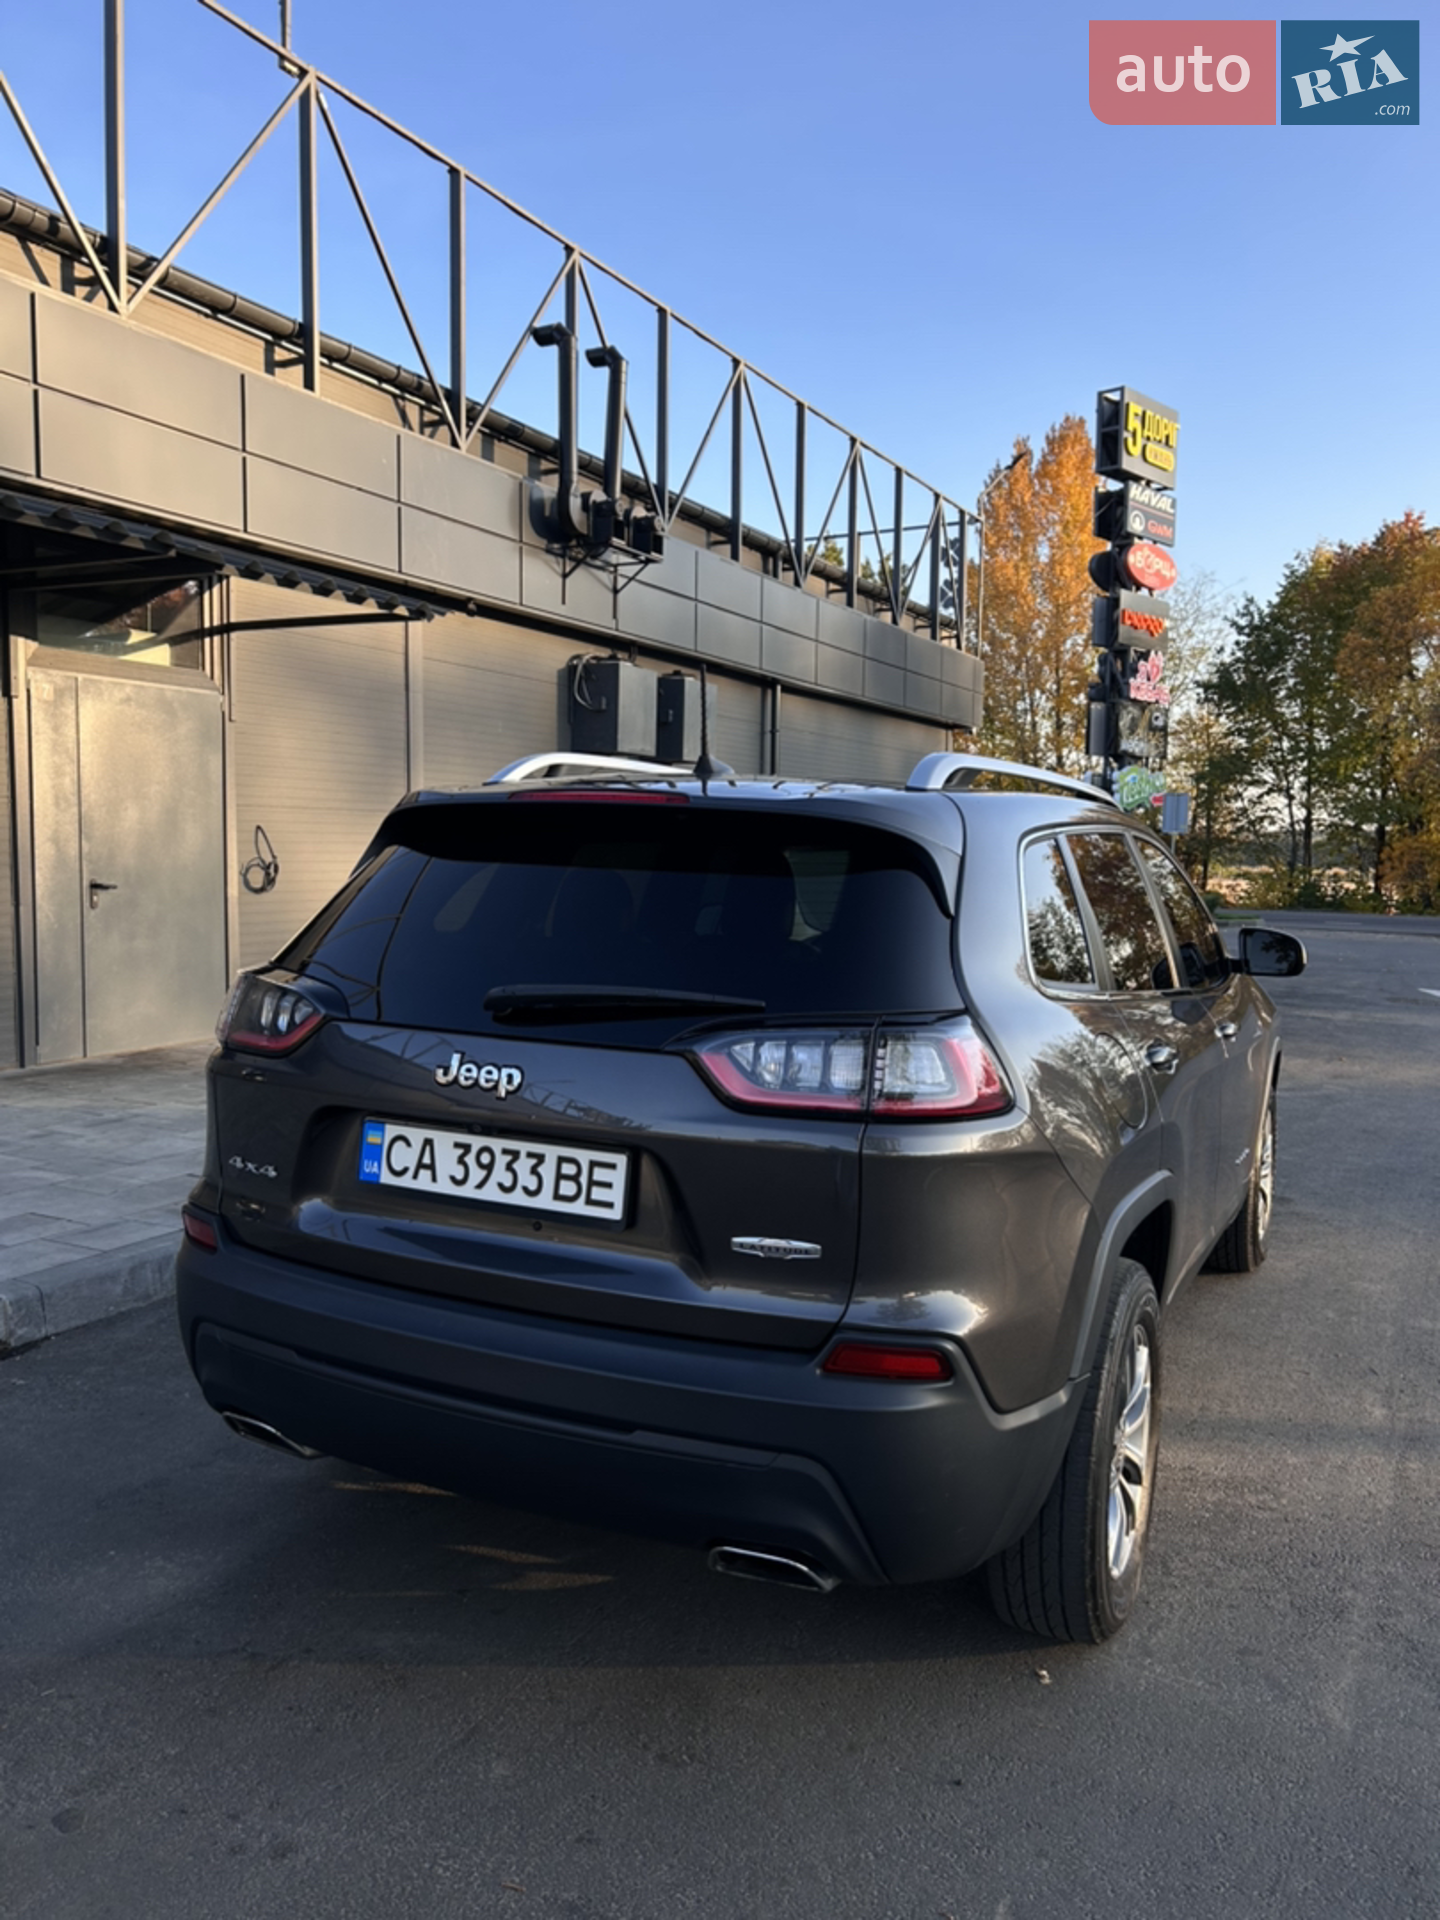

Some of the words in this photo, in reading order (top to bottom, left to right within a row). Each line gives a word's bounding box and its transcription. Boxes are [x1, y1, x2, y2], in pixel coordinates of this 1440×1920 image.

[1125, 401, 1143, 458] 5
[1129, 483, 1175, 513] HAVAL
[434, 1051, 524, 1097] Jeep
[228, 1155, 278, 1179] 4x4
[363, 1159, 379, 1175] UA
[385, 1134, 438, 1184] CA
[449, 1141, 545, 1198] 3933
[552, 1156, 618, 1210] BE
